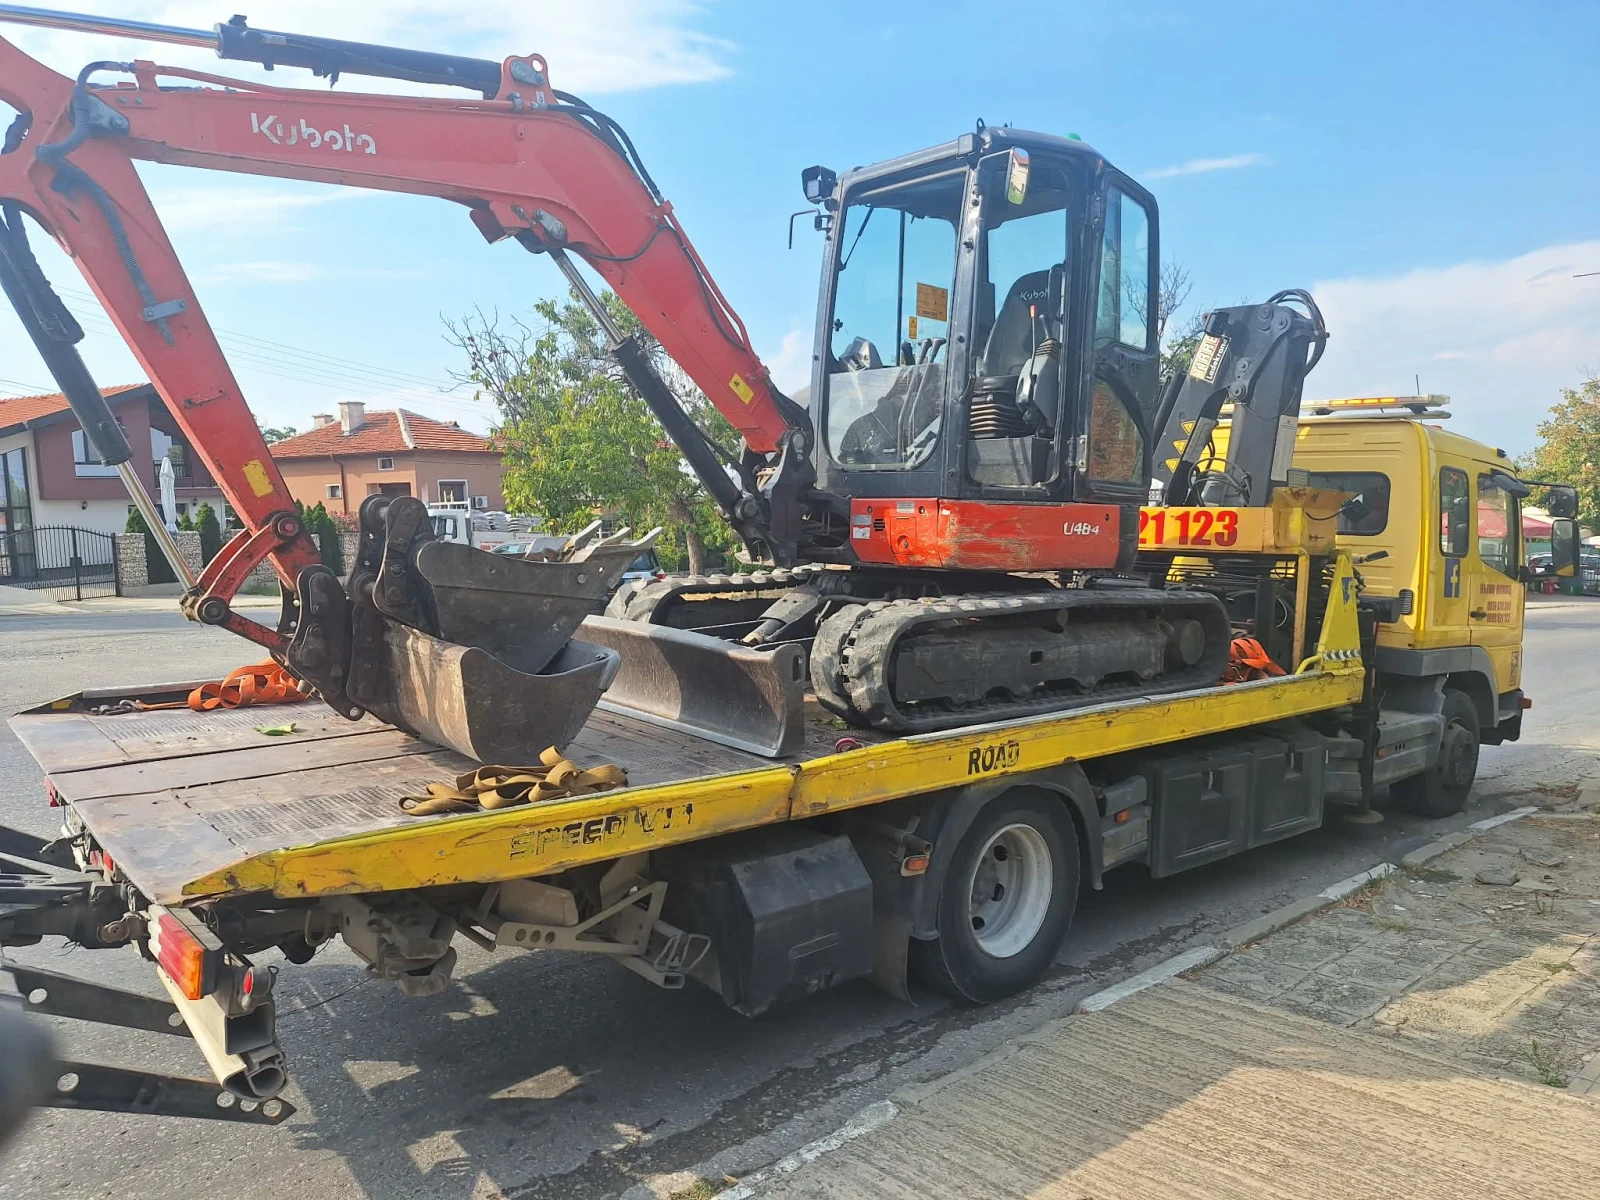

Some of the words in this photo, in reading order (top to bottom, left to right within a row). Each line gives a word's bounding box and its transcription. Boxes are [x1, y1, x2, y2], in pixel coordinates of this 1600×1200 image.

[250, 112, 376, 155] Kubota
[1174, 510, 1239, 547] 123
[968, 741, 1020, 775] ROAD
[510, 813, 629, 861] SPEED
